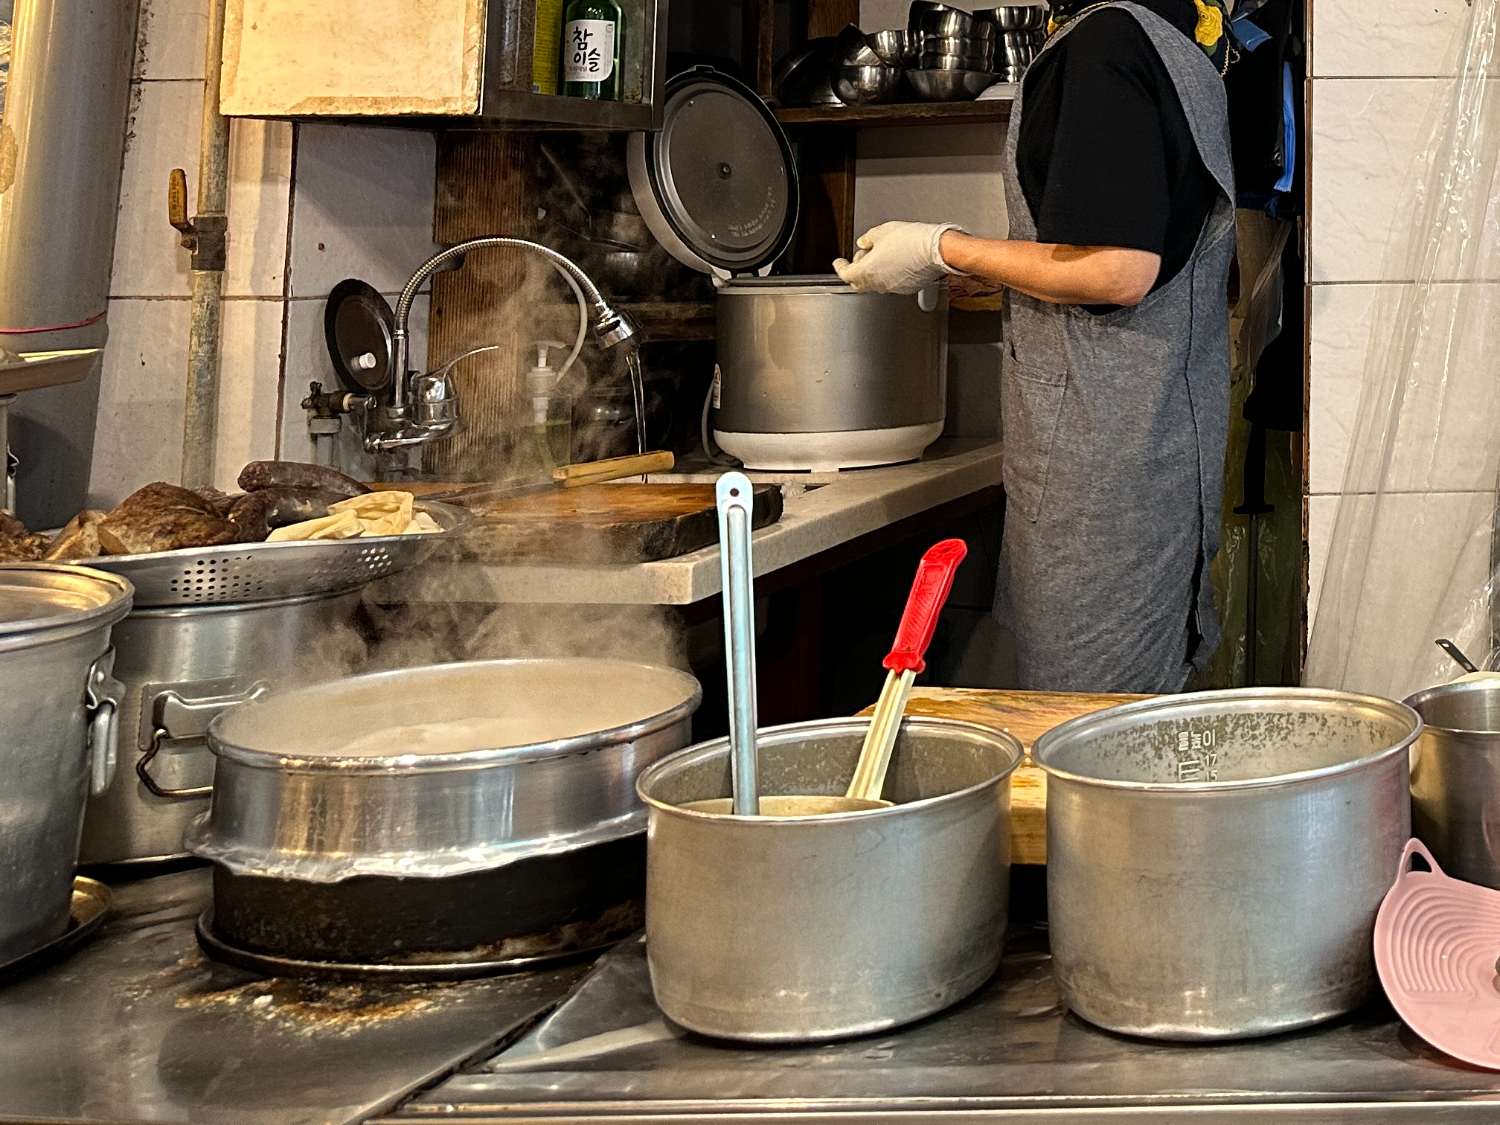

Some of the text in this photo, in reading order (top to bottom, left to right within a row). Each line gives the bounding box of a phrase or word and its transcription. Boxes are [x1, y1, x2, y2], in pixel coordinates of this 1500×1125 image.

[573, 26, 594, 50] 참
[574, 48, 600, 72] 이슬
[1205, 754, 1217, 766] 17
